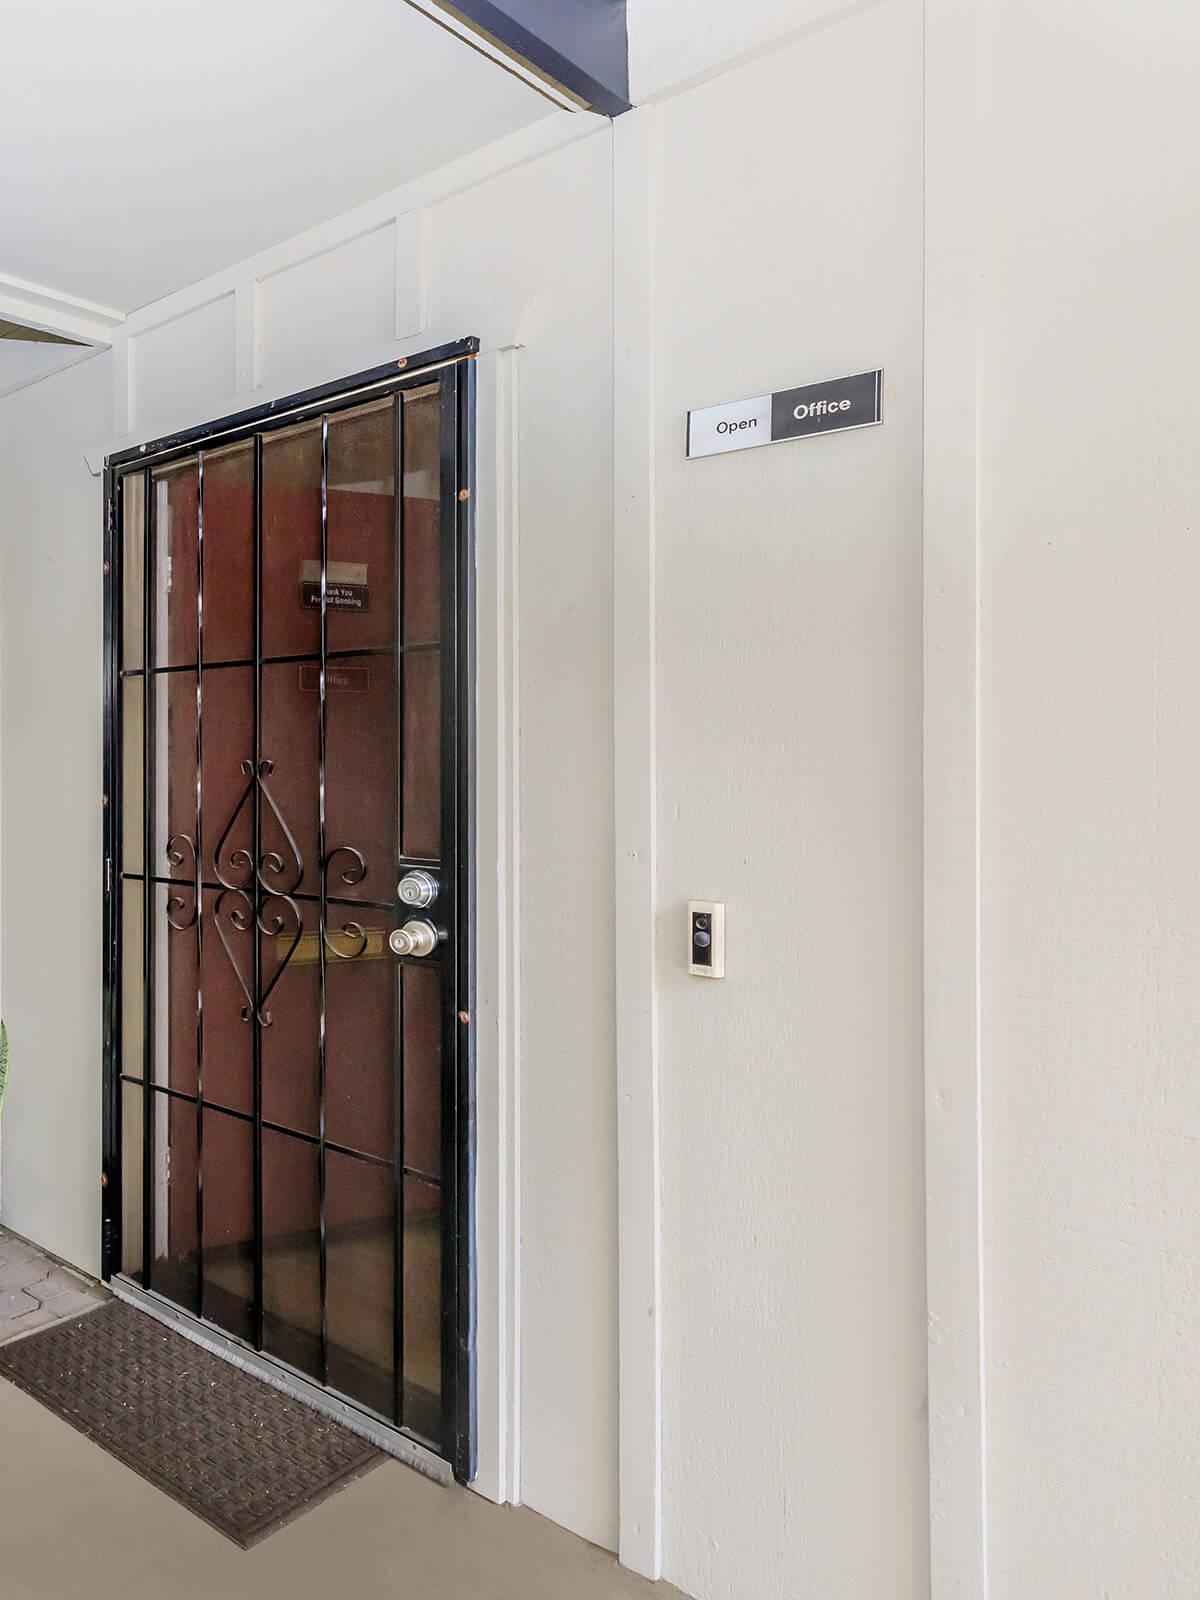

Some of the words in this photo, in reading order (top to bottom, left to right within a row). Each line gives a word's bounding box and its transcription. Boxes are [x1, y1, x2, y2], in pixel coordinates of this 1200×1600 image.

[716, 417, 757, 434] Open
[793, 399, 851, 420] Office
[340, 589, 353, 597] You
